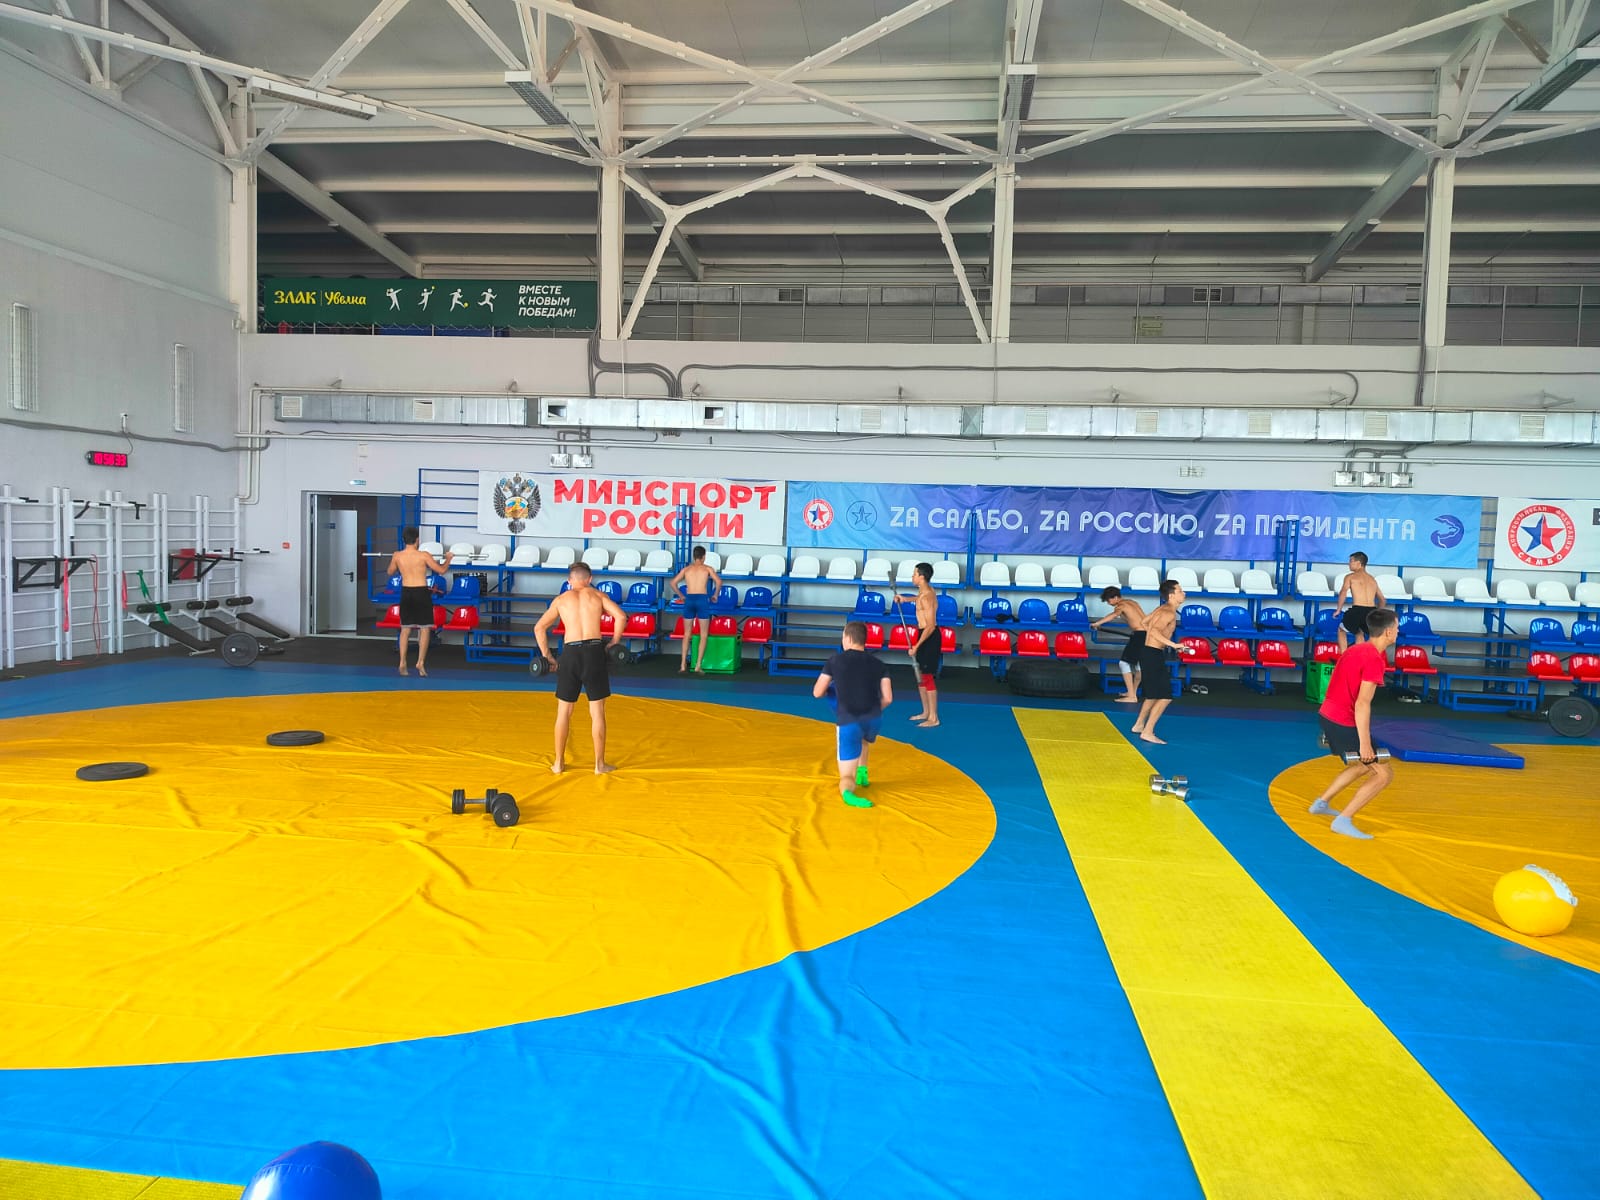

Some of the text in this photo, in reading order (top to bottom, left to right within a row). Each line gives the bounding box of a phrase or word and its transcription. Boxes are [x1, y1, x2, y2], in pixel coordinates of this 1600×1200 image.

[518, 285, 562, 294] ВМЕСТЕ
[274, 290, 367, 305] ЗЛАК Увелка
[518, 296, 570, 306] К НОВЫМ
[518, 307, 577, 318] ПОБЕДАМ!
[553, 479, 777, 511] МИНСПОРТ
[582, 508, 744, 539] РОССИИ
[889, 506, 919, 529] ZA
[927, 507, 1029, 534] САМБО,
[1039, 510, 1070, 532] ZA
[1079, 511, 1204, 538] РОССИЮ,
[1214, 513, 1246, 536] ZA
[1518, 551, 1562, 565] САМБО
